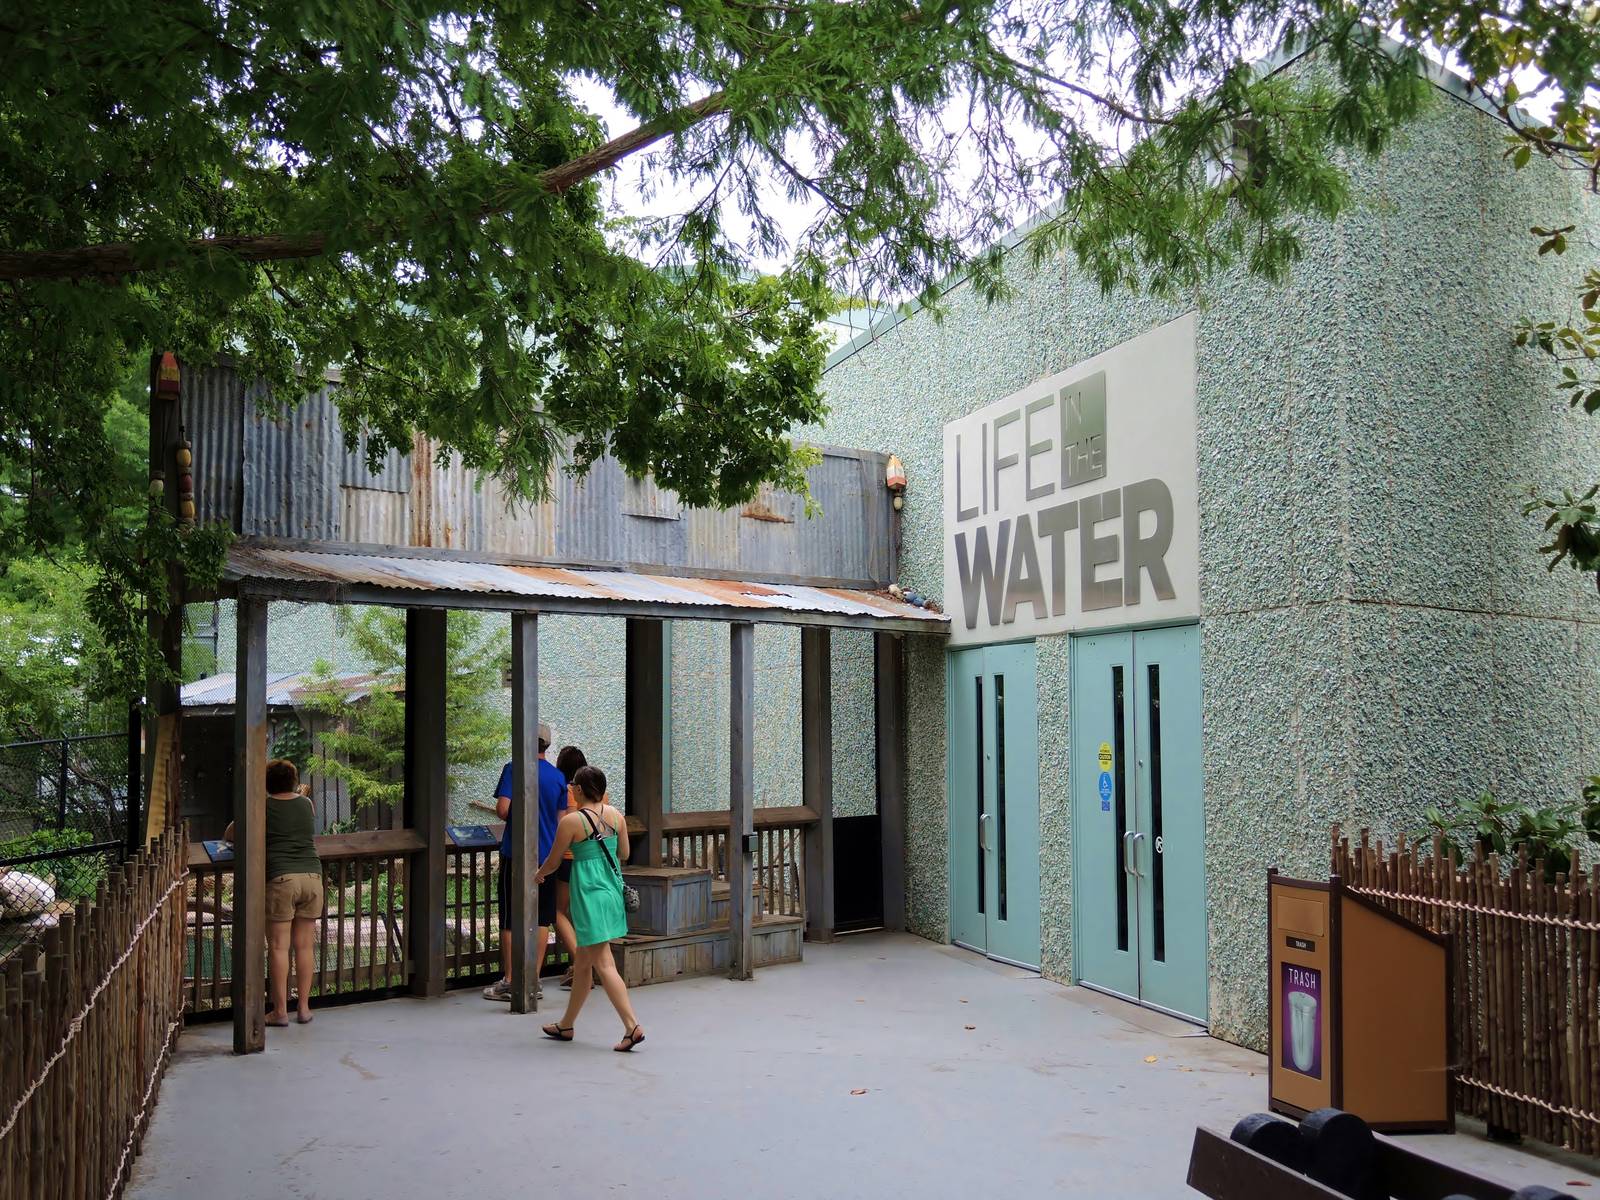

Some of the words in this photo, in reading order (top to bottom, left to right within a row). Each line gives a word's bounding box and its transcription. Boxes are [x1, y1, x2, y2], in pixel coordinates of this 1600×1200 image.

[1064, 391, 1081, 427] IN
[956, 393, 1055, 522] LIFE
[1065, 434, 1103, 478] THE
[954, 478, 1176, 629] WATER
[1288, 968, 1316, 989] TRASH
